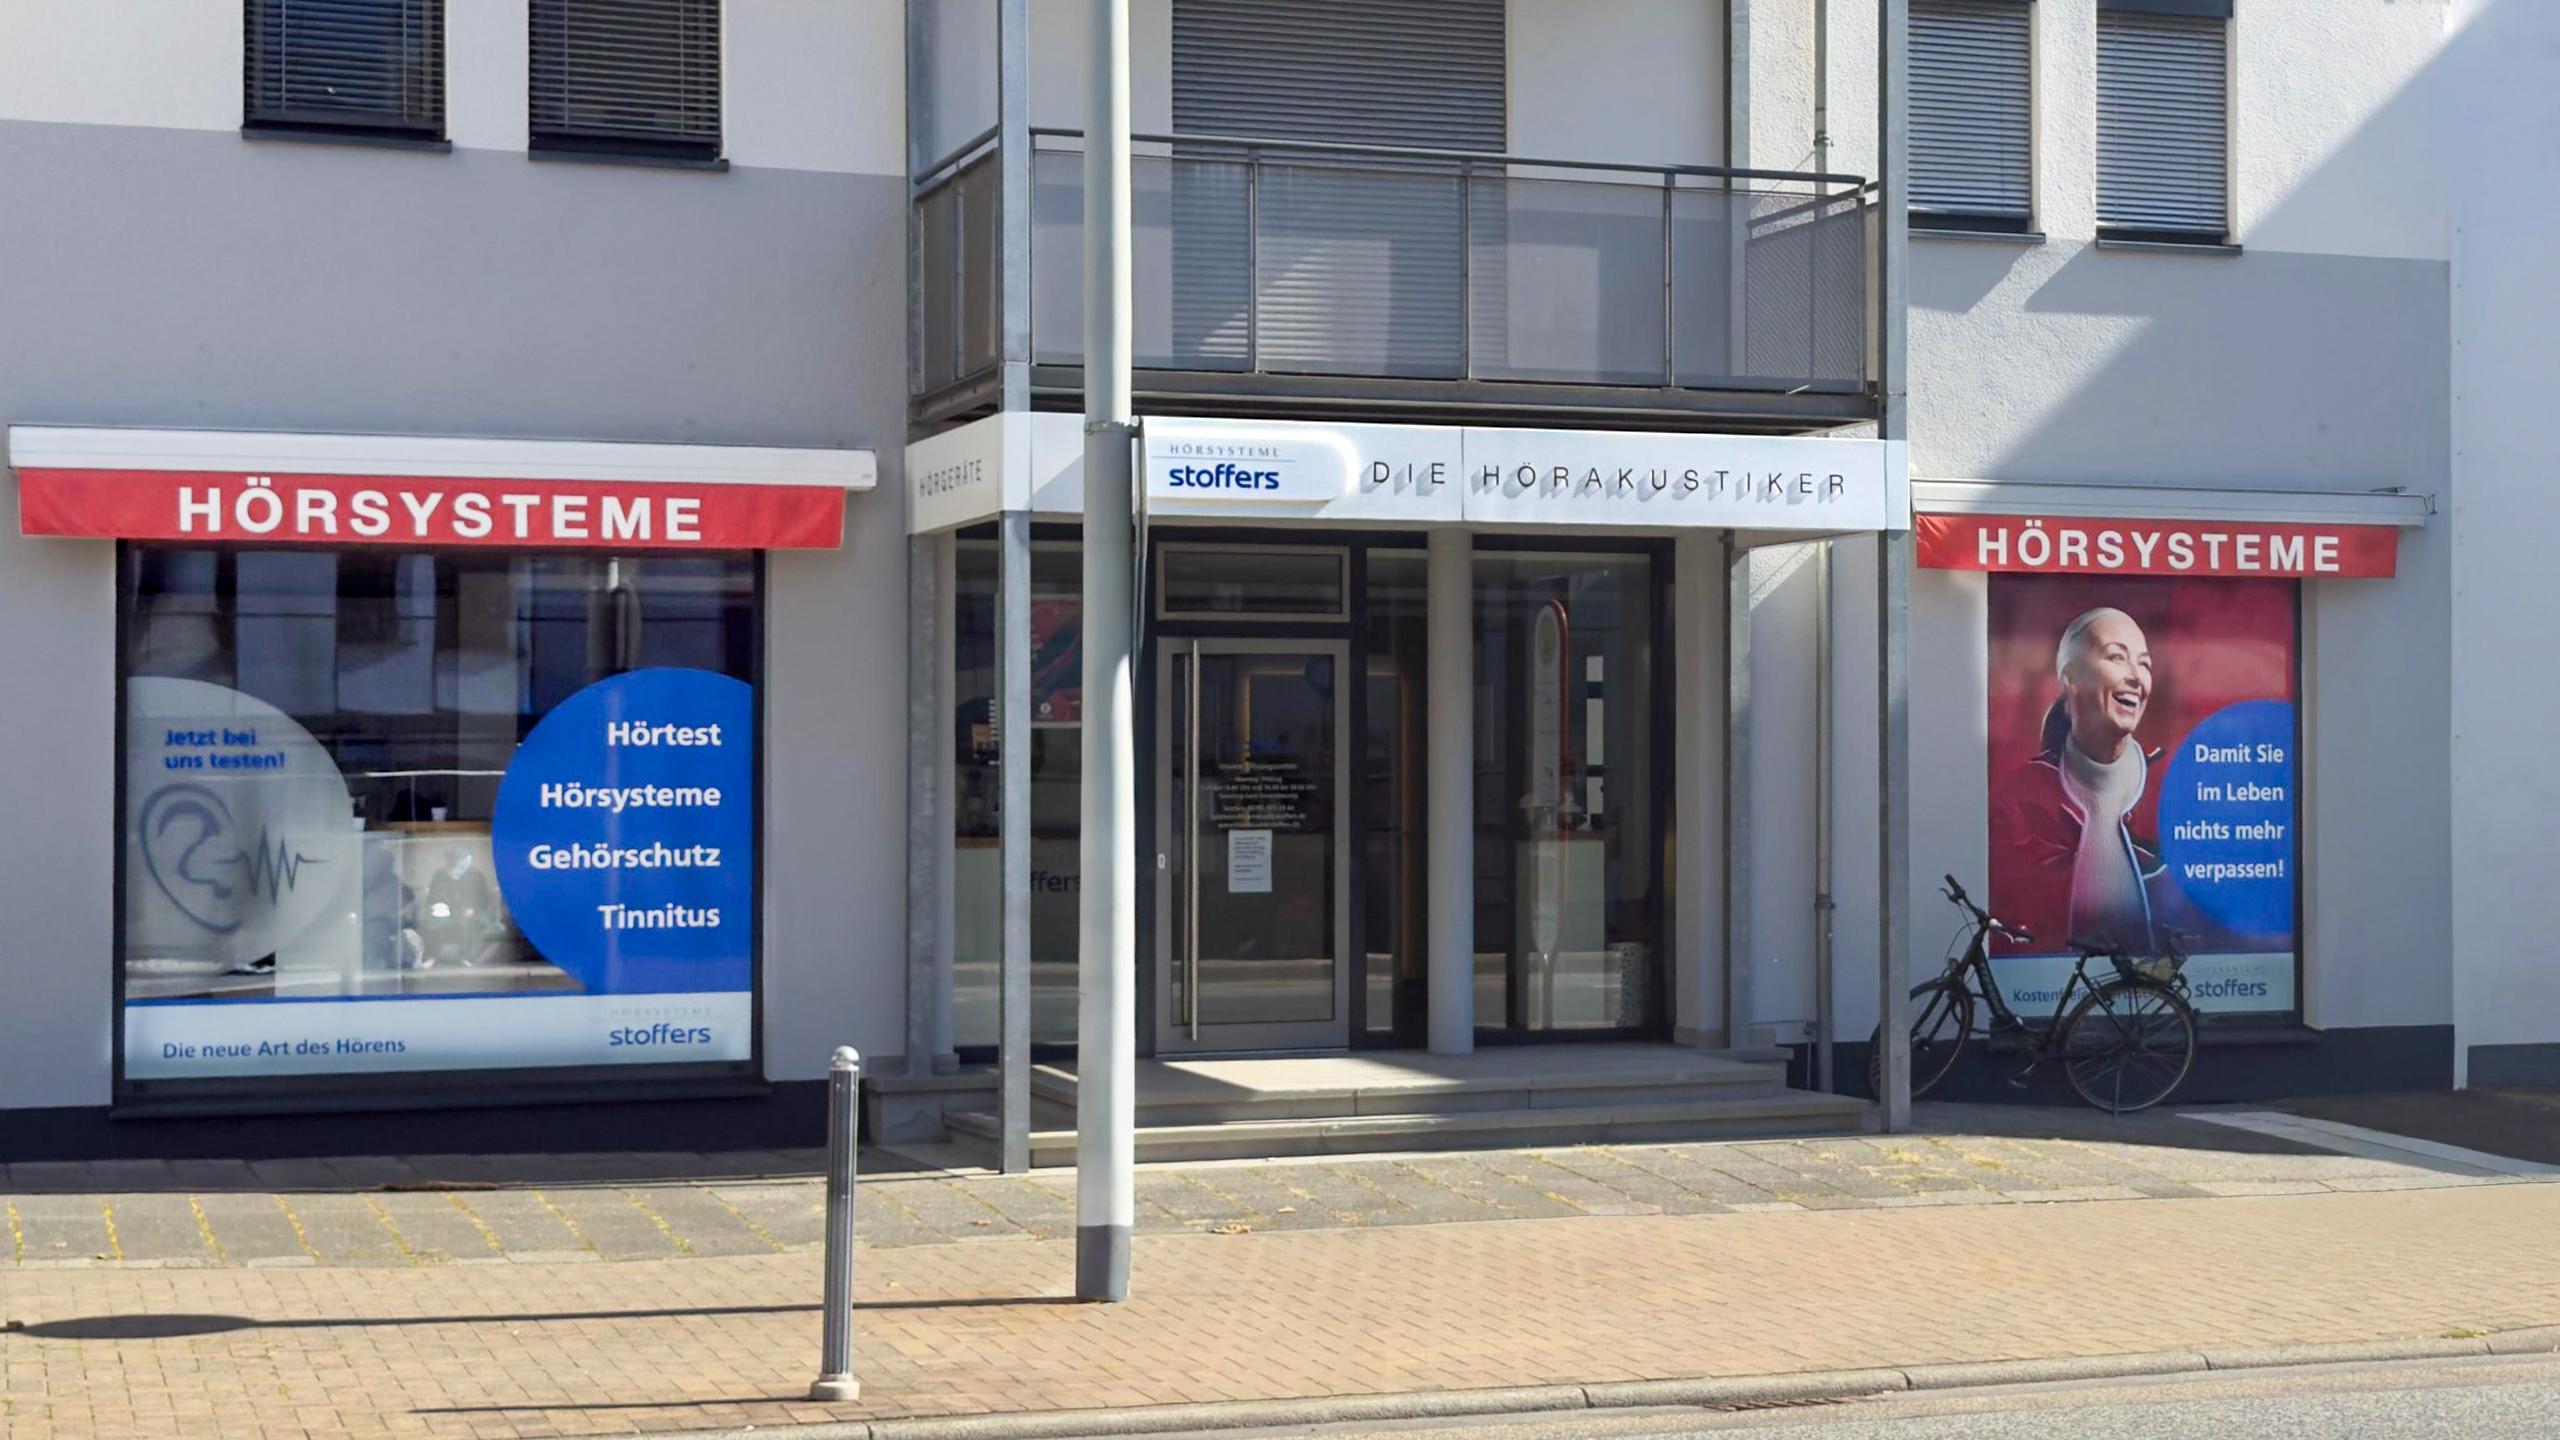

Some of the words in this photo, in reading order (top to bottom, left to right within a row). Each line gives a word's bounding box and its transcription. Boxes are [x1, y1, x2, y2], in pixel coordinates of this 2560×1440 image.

[1169, 464, 1280, 490] stoffers
[1373, 461, 1445, 485] DIE
[1483, 463, 1845, 495] HÖRAKUSTIKER
[179, 476, 701, 541] HÖRSYSTEME
[1978, 519, 2339, 572] HÖRSYSTEME
[165, 729, 217, 746] Jetzt
[223, 727, 256, 746] bei
[608, 720, 722, 746] Hörtest
[165, 755, 203, 769] uns
[209, 752, 285, 769] testen!
[2195, 743, 2252, 763] Damit
[2256, 743, 2284, 763] Sie
[541, 782, 722, 814] Hörsysteme
[2197, 781, 2221, 801] im
[2226, 781, 2284, 801] Leben
[2174, 820, 2230, 840] nichts
[2235, 819, 2285, 839] mehr
[529, 842, 721, 870] Gehörschutz
[2184, 859, 2285, 883] verpassen!
[597, 903, 721, 929] Tinnitus
[2194, 977, 2267, 998] stoffers
[609, 1022, 711, 1046] stoffers
[163, 1042, 196, 1059] Die
[202, 1043, 252, 1058] neue
[258, 1040, 290, 1056] Art
[296, 1039, 330, 1055] des
[336, 1038, 406, 1055] Hörens
